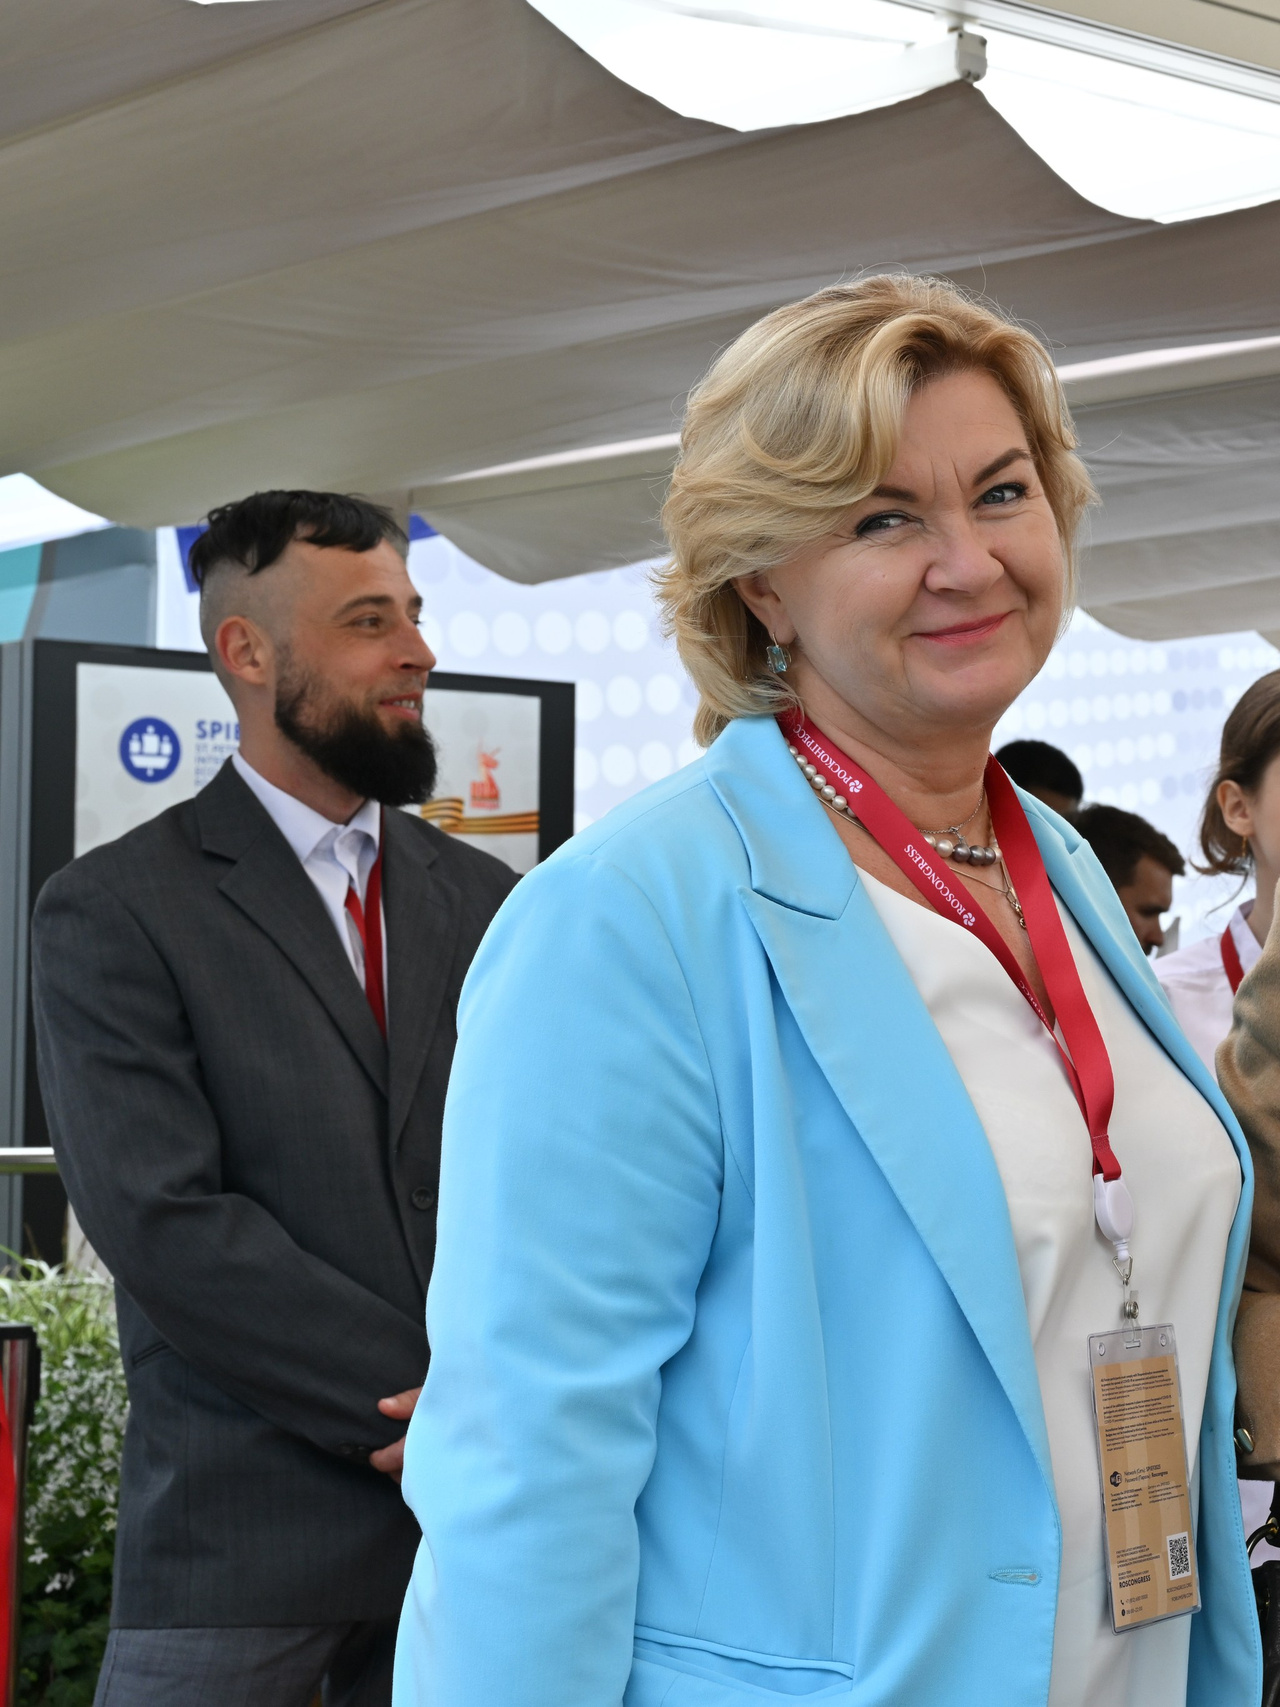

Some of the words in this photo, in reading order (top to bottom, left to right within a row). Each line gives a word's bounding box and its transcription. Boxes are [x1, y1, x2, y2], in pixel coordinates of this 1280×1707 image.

[793, 724, 852, 784] РОСКОНГРЕСС
[904, 844, 966, 915] ROSCONGRESS
[1119, 1575, 1151, 1588] ROSCONGRESS
